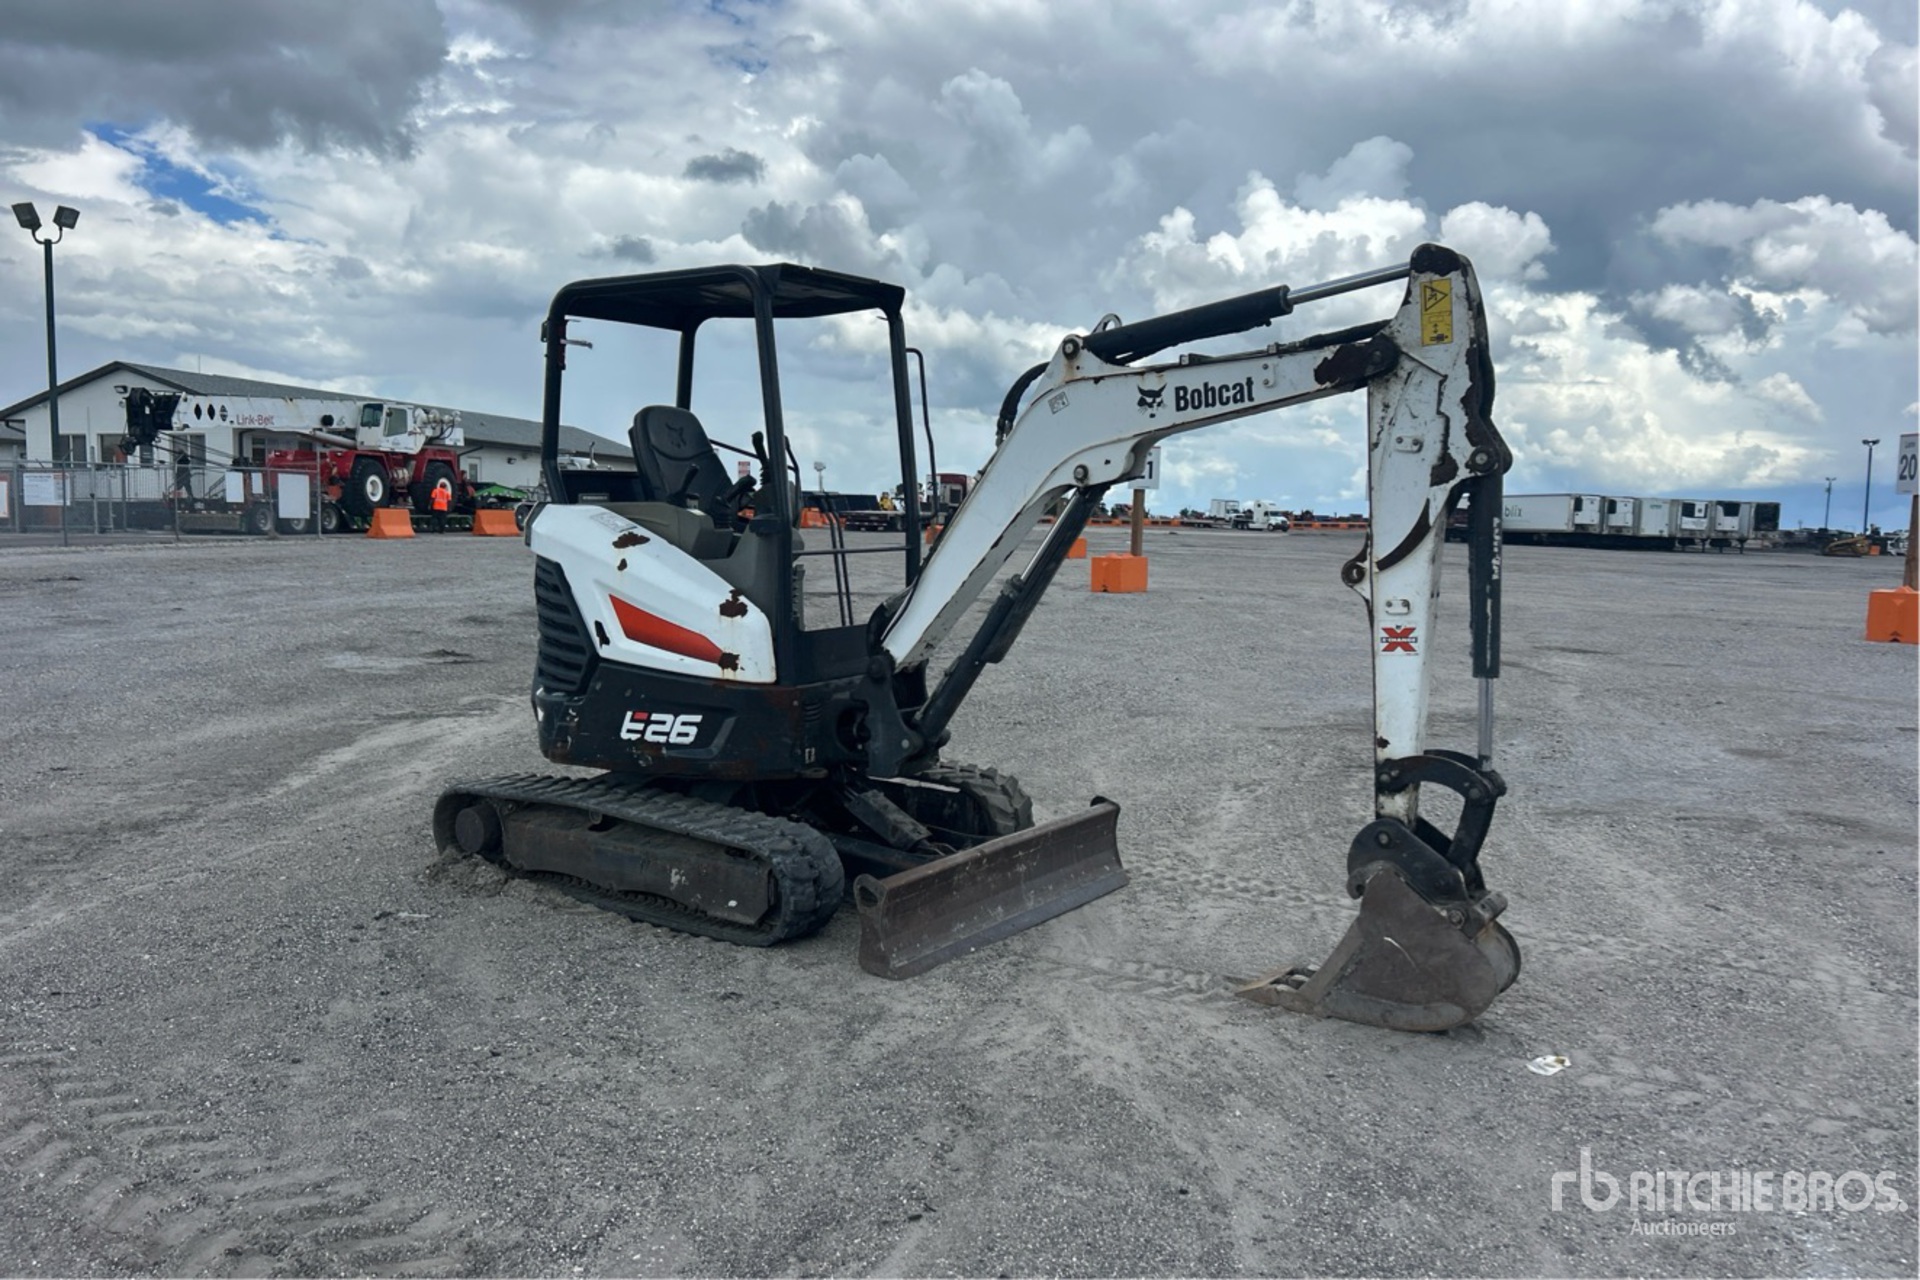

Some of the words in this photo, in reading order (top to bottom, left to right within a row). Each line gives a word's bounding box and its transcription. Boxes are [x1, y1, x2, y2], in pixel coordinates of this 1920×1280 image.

[1174, 376, 1255, 412] Bobcat
[1899, 453, 1918, 481] 20
[1504, 504, 1522, 518] blix
[620, 710, 703, 745] E26
